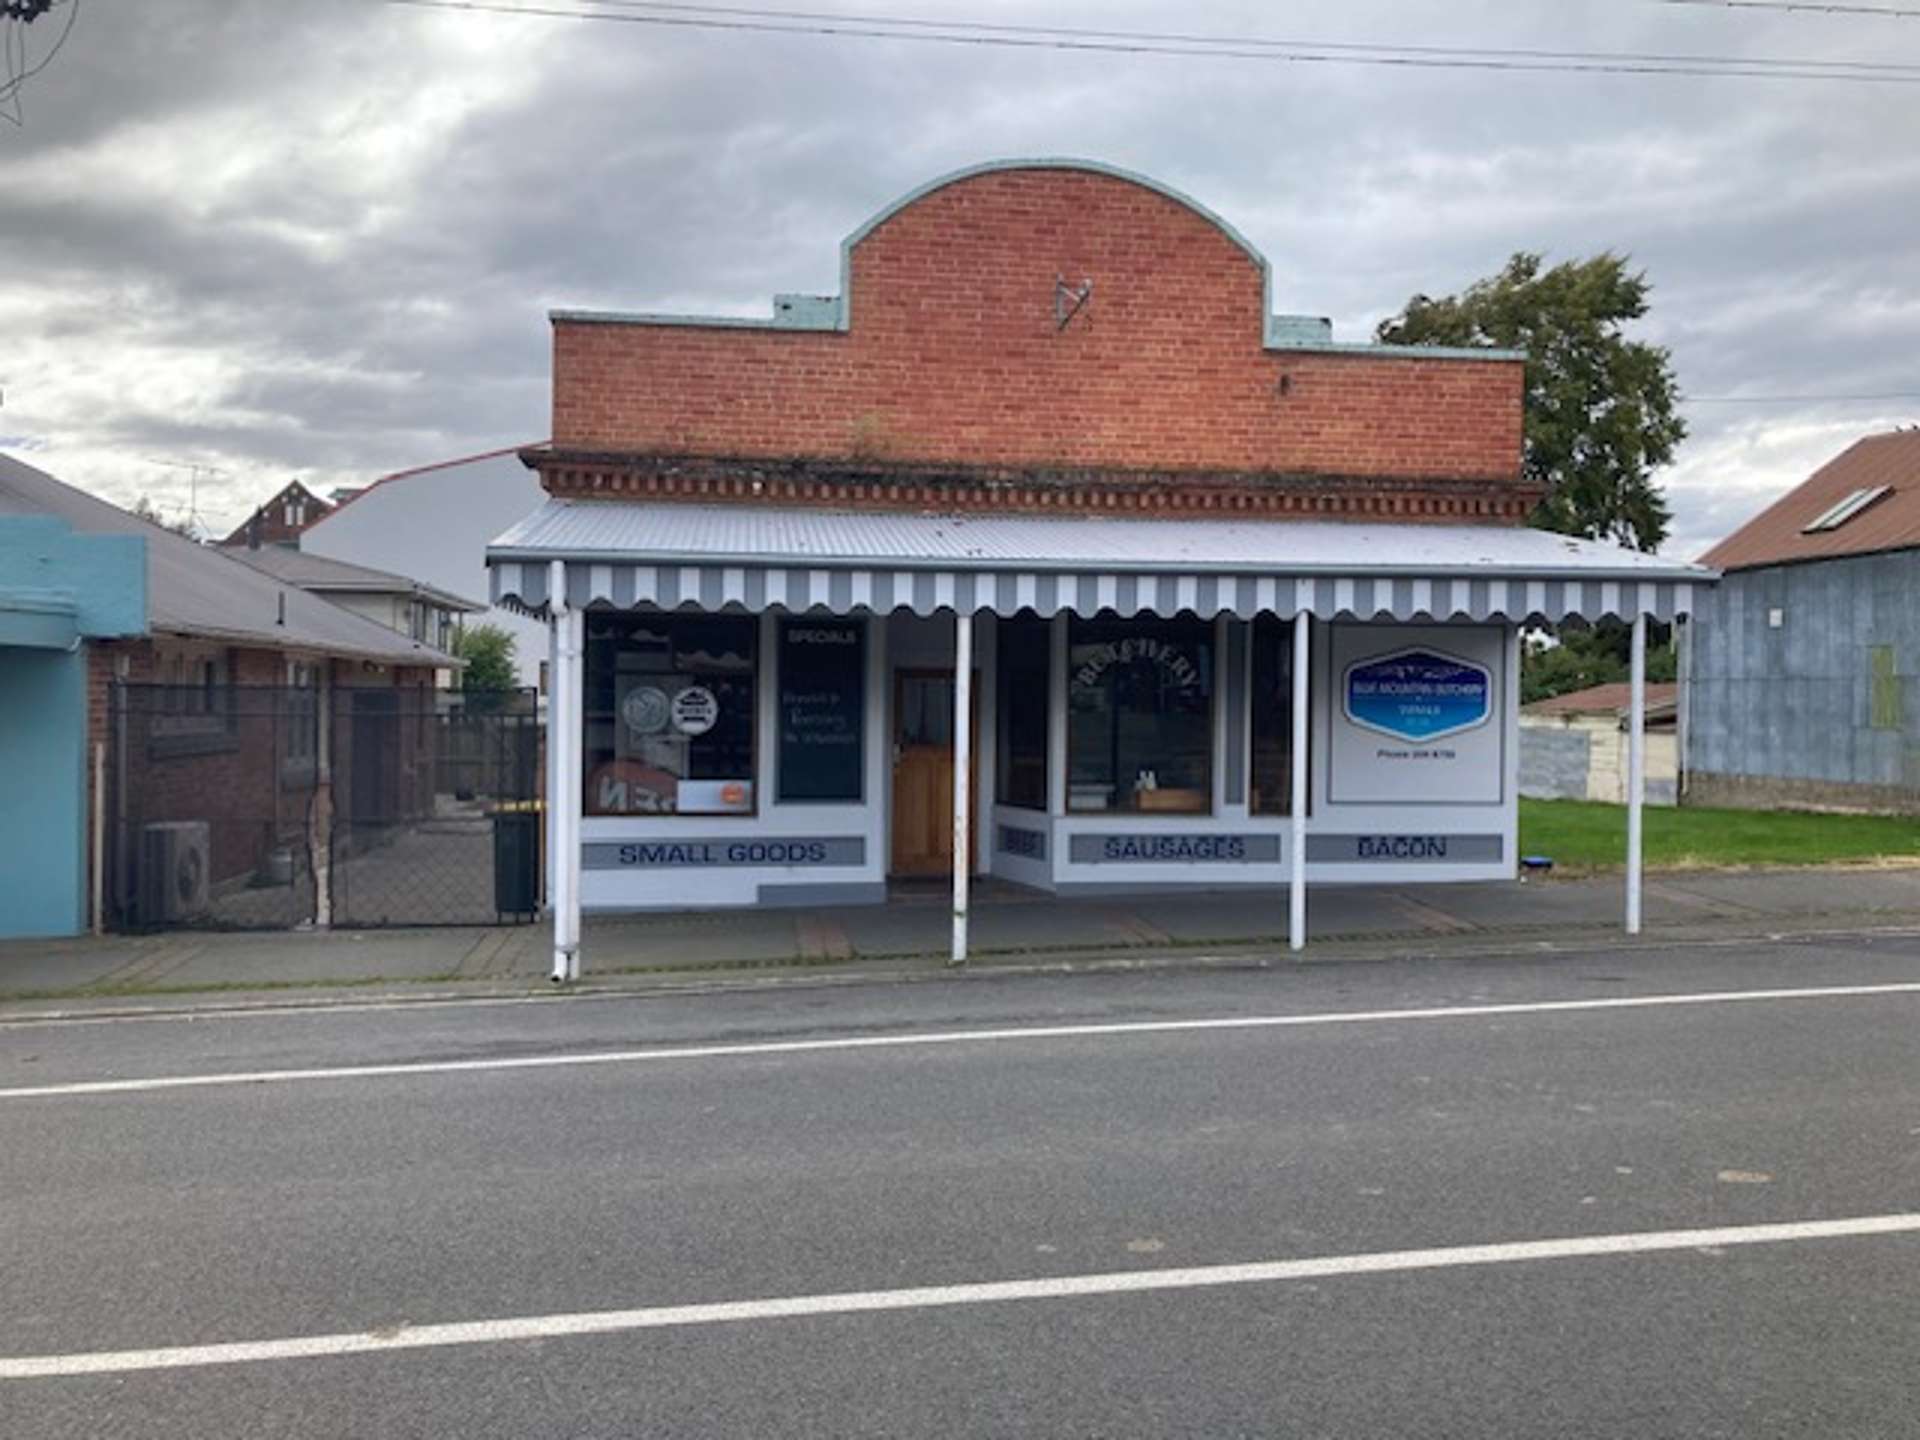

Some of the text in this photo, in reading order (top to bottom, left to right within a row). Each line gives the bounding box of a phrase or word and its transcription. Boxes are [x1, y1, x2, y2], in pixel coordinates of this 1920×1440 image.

[787, 629, 857, 644] SPECIALS
[1076, 637, 1199, 686] BUTCHERY
[619, 841, 826, 866] SMALL GOODS
[1104, 835, 1245, 860] SAUSAGES
[1357, 836, 1447, 858] BACON
